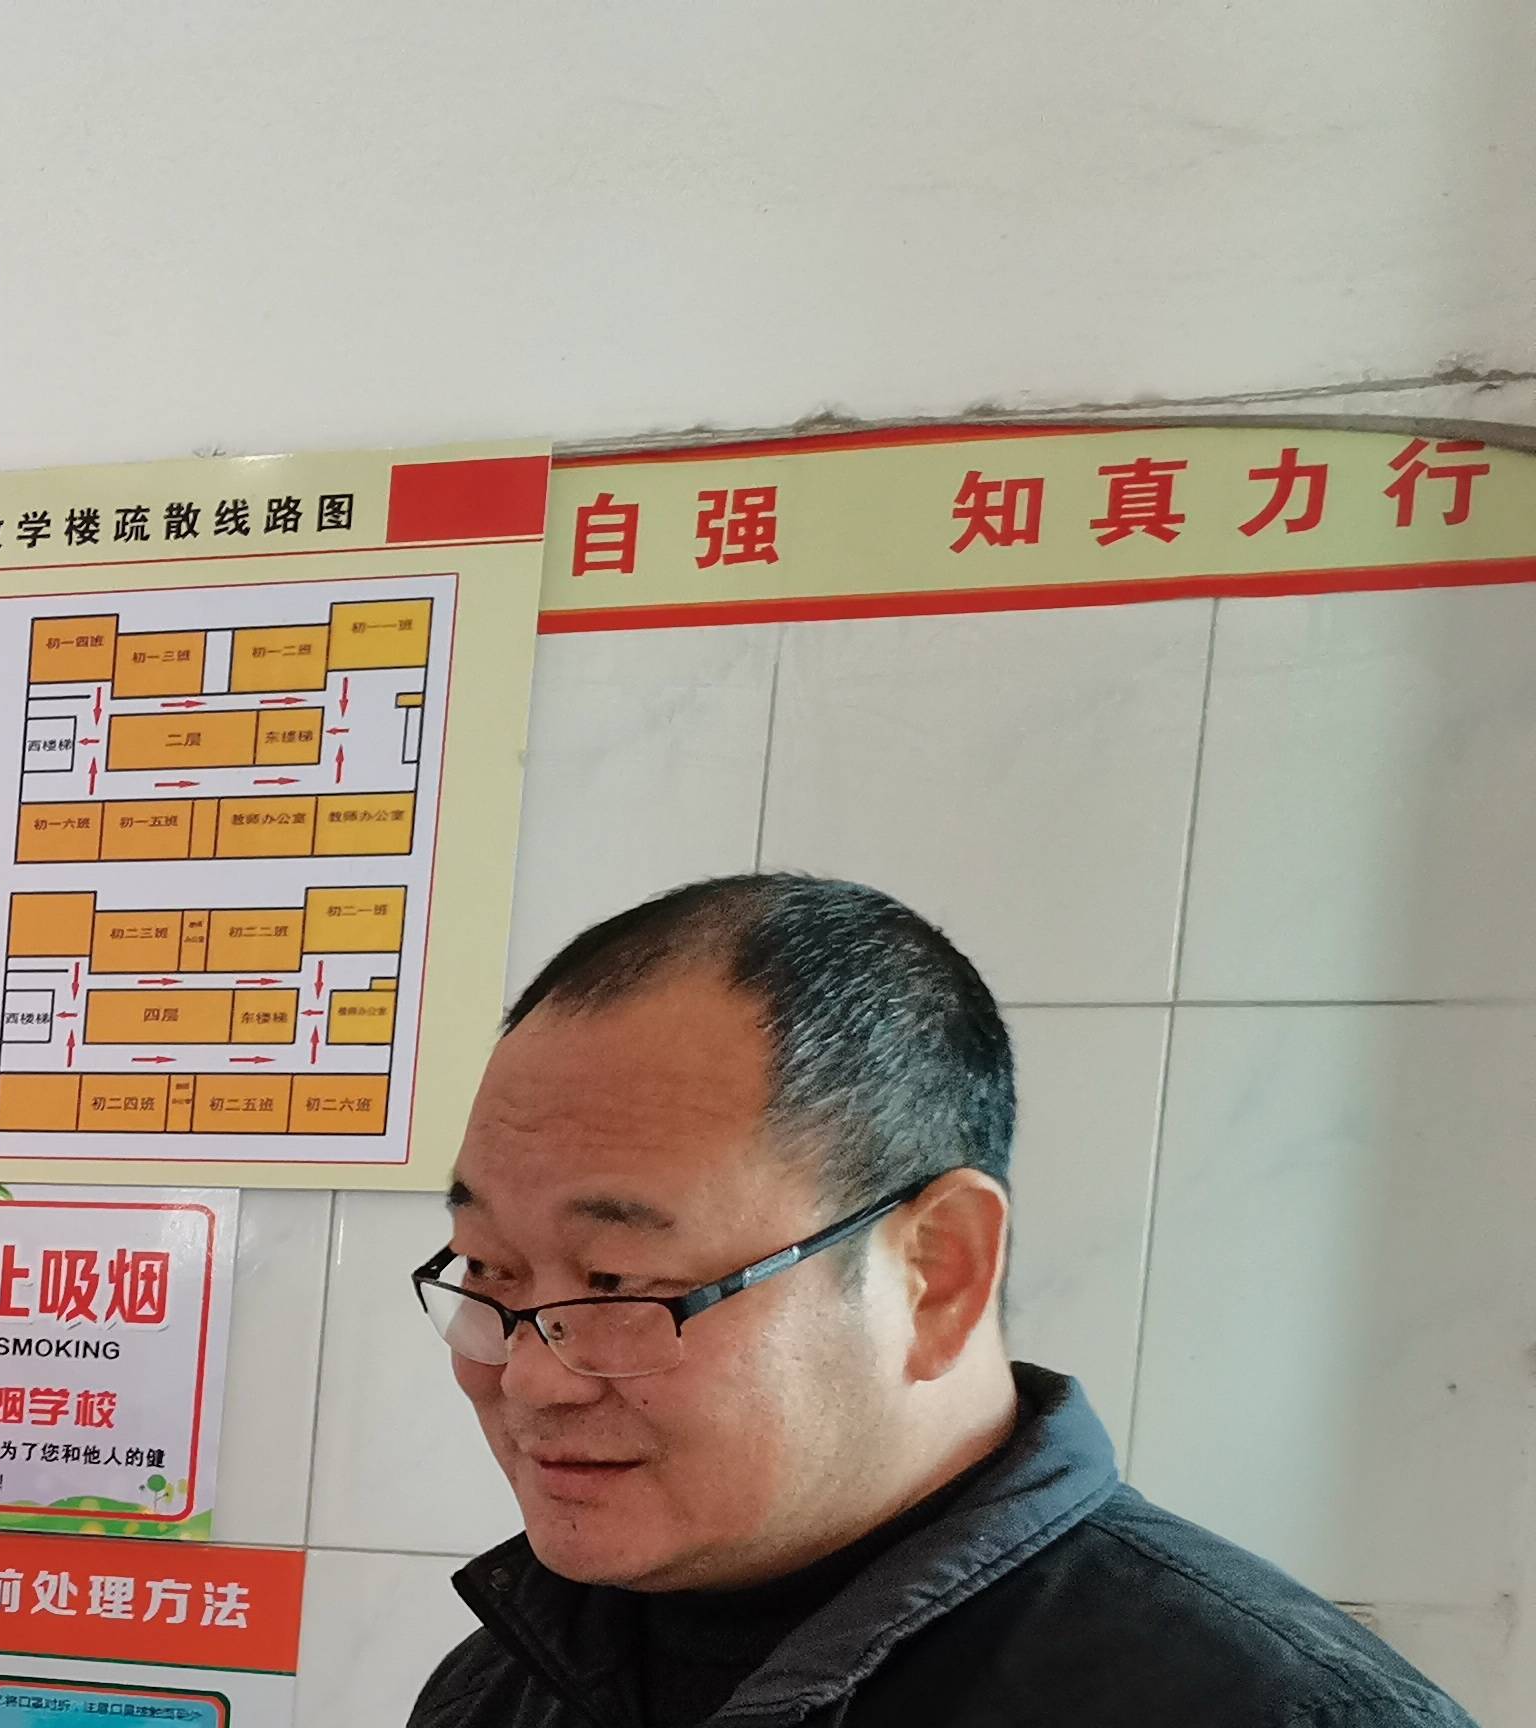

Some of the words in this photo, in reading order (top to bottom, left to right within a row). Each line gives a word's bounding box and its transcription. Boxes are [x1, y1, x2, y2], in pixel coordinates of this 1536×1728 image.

[572, 485, 780, 577] 自强
[949, 437, 1492, 555] 知真力行
[46, 635, 104, 650] 初一四班
[166, 731, 202, 748] 二层
[264, 729, 314, 744] 东楼梯
[27, 739, 73, 752] 西楼梯
[33, 817, 91, 831] 初一六班
[119, 815, 178, 830] 初一五班
[231, 812, 307, 827] 教师办公室
[328, 809, 405, 824] 教师办公室
[327, 903, 388, 917] 初二一班
[109, 926, 168, 941] 初二三班
[228, 925, 289, 939] 初二二班
[4, 1012, 51, 1026] 西楼梯
[143, 1008, 179, 1023] 四层
[241, 1011, 289, 1025] 东楼梯
[91, 1097, 155, 1112] 初二四班
[209, 1097, 274, 1113] 初二五班
[306, 1097, 371, 1112] 初二六班
